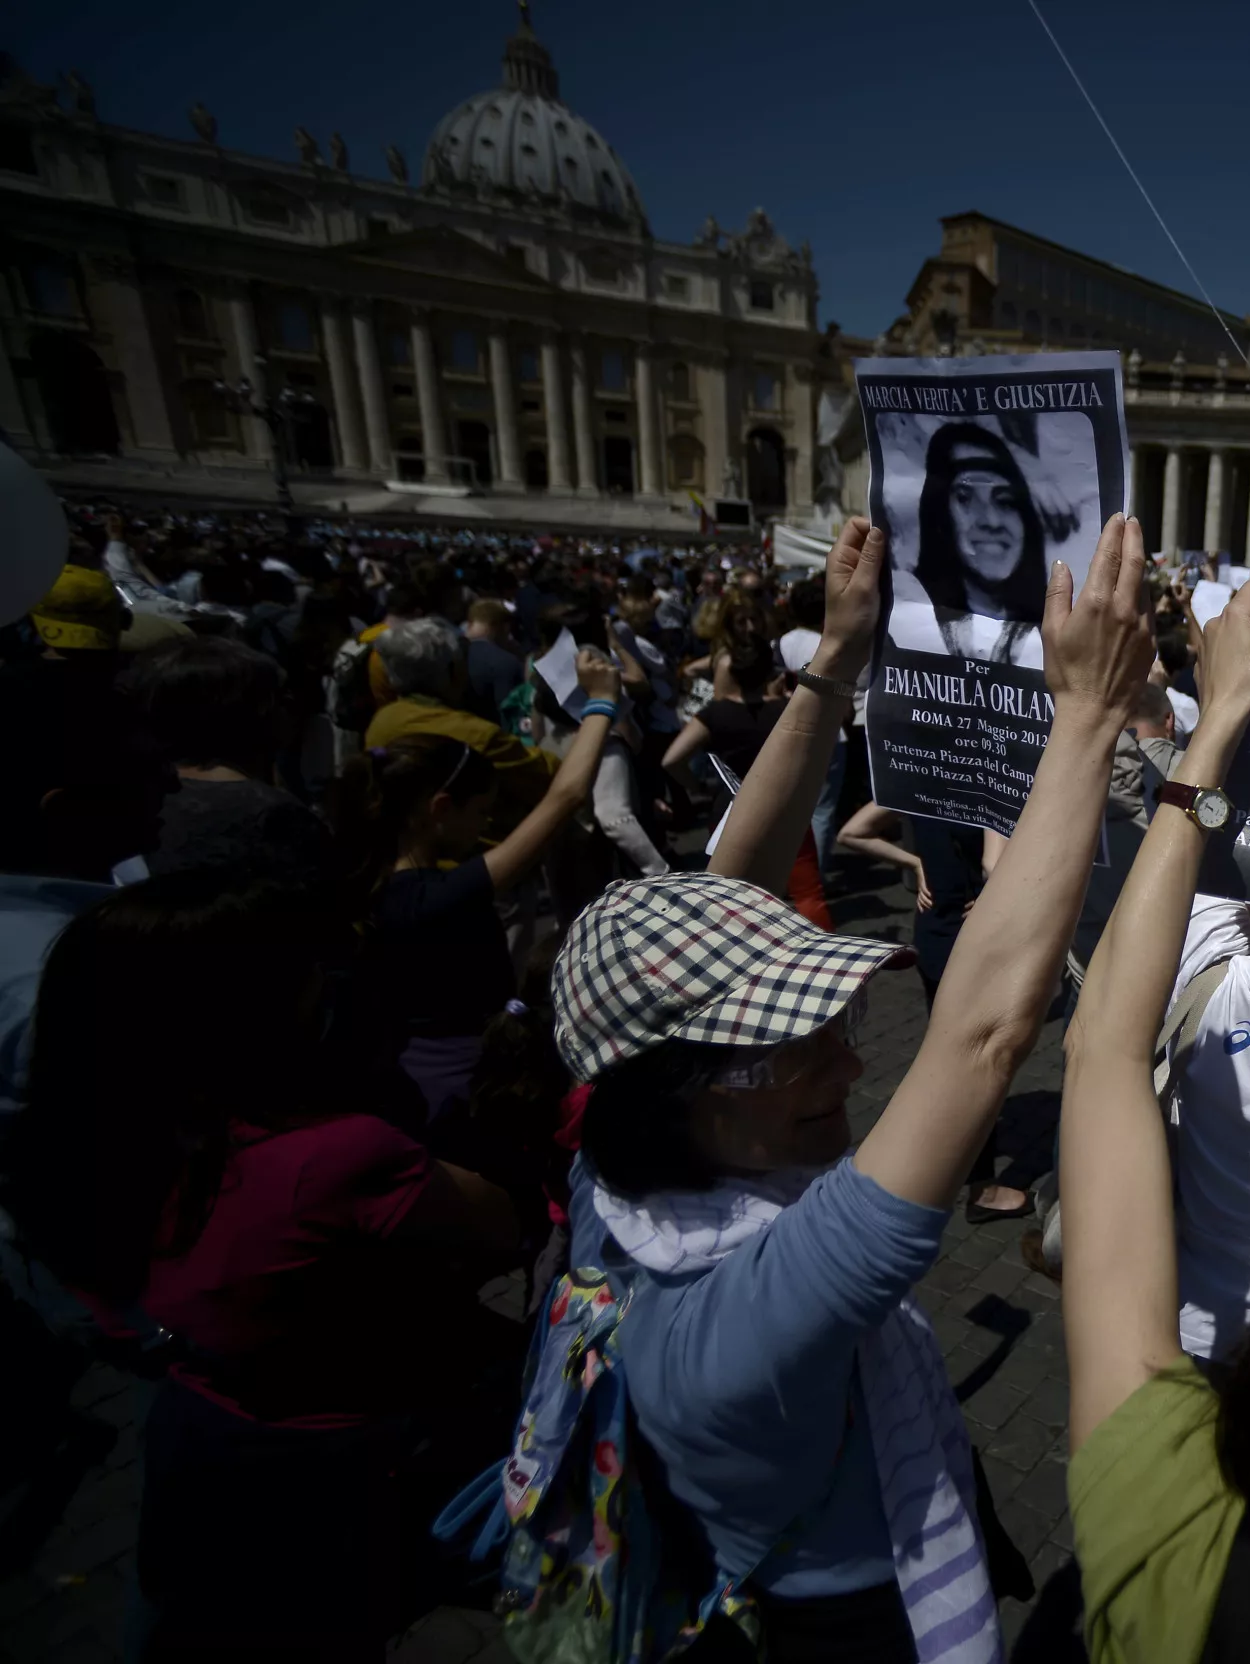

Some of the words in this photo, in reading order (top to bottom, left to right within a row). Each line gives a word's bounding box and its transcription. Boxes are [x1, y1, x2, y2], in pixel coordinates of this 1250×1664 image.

[864, 384, 912, 409] MARCIA
[975, 387, 989, 411] E
[994, 382, 1104, 410] GIUSTIZIA
[964, 660, 990, 675] Per
[884, 666, 986, 709] EMANUELA
[990, 683, 1055, 723] ORLAN
[911, 708, 953, 728] ROMA
[957, 716, 971, 730] 27
[977, 718, 1017, 743] Maggio
[1020, 730, 1048, 748] 2012
[883, 739, 936, 760] Partenza
[940, 749, 982, 767] Piazza
[984, 757, 1000, 773] del
[1002, 763, 1034, 788] Camp
[954, 737, 979, 748] ore
[981, 738, 1007, 756] 09.30
[889, 757, 929, 775] Arrivo
[932, 765, 973, 783] Piazza
[976, 772, 986, 785] S.
[988, 776, 1019, 798] Pietro
[963, 811, 970, 820] la
